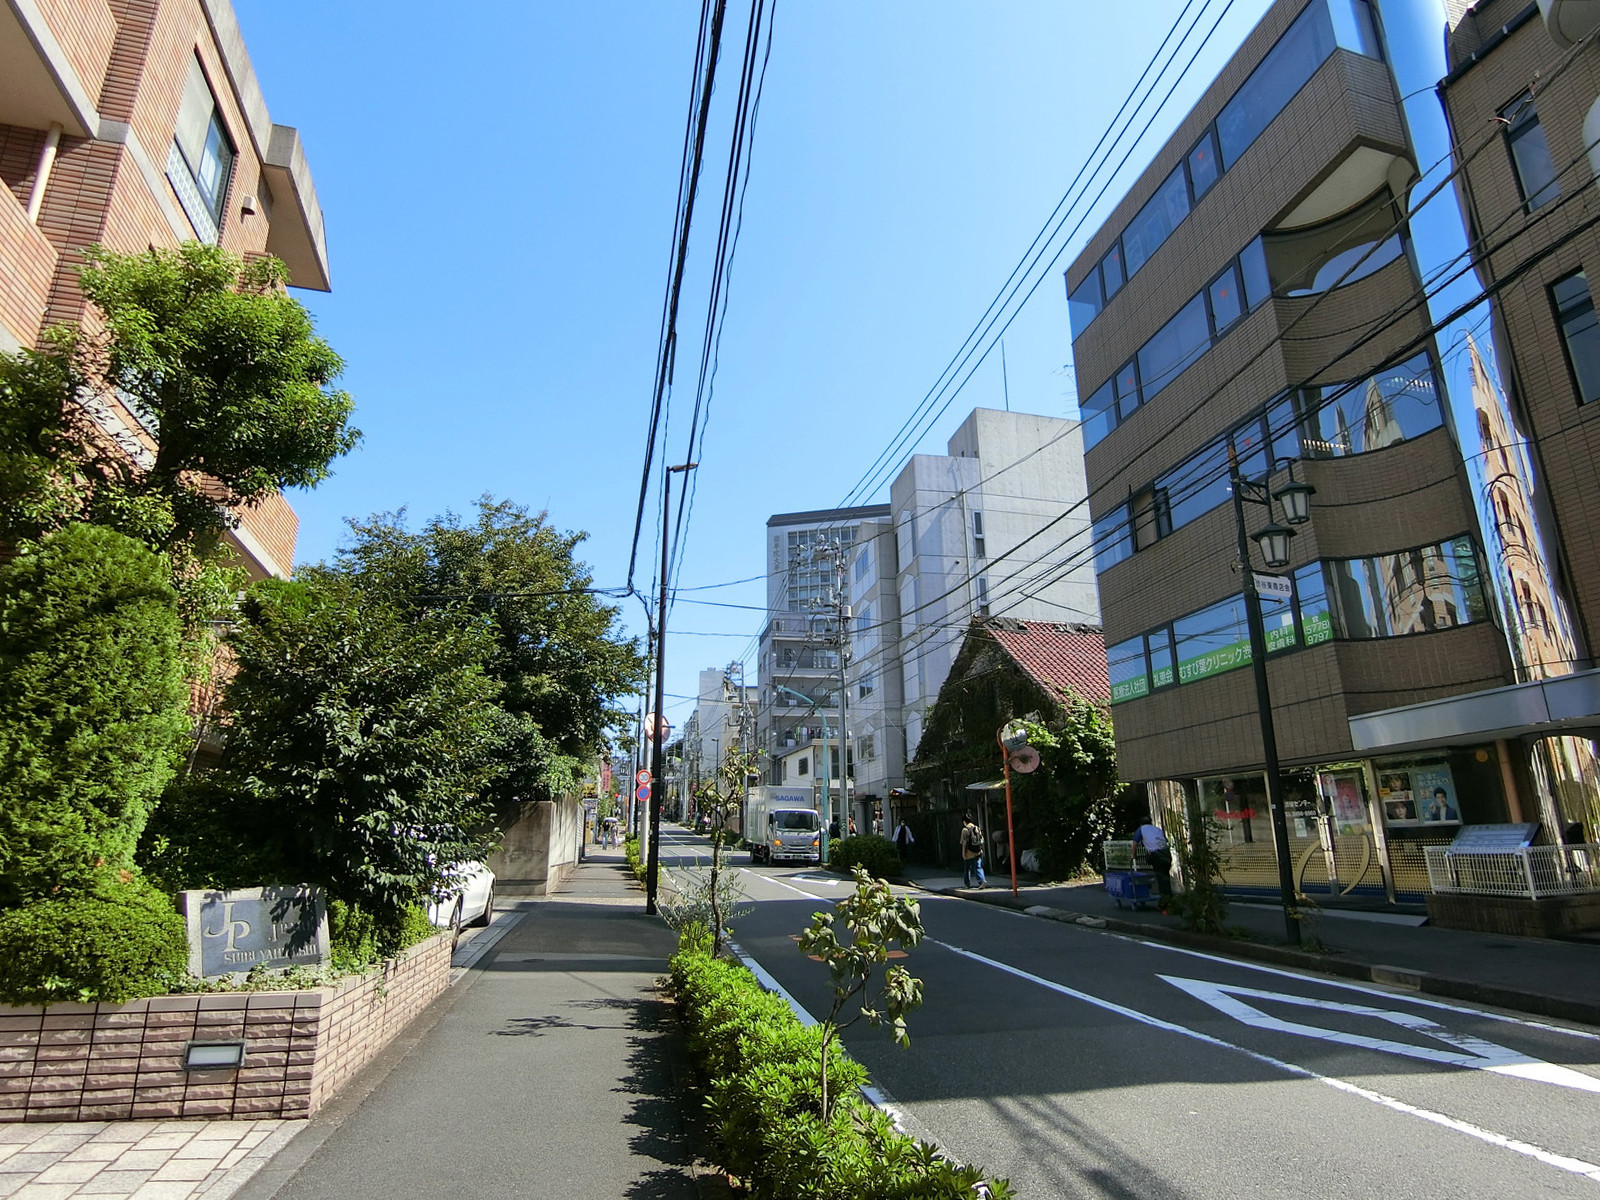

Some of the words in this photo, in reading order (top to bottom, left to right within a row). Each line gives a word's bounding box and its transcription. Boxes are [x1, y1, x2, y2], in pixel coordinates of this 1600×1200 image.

[1269, 627, 1288, 639] 内科
[1304, 619, 1329, 635] (5778)
[1267, 635, 1295, 651] 皮膚科
[1308, 631, 1329, 645] 9797
